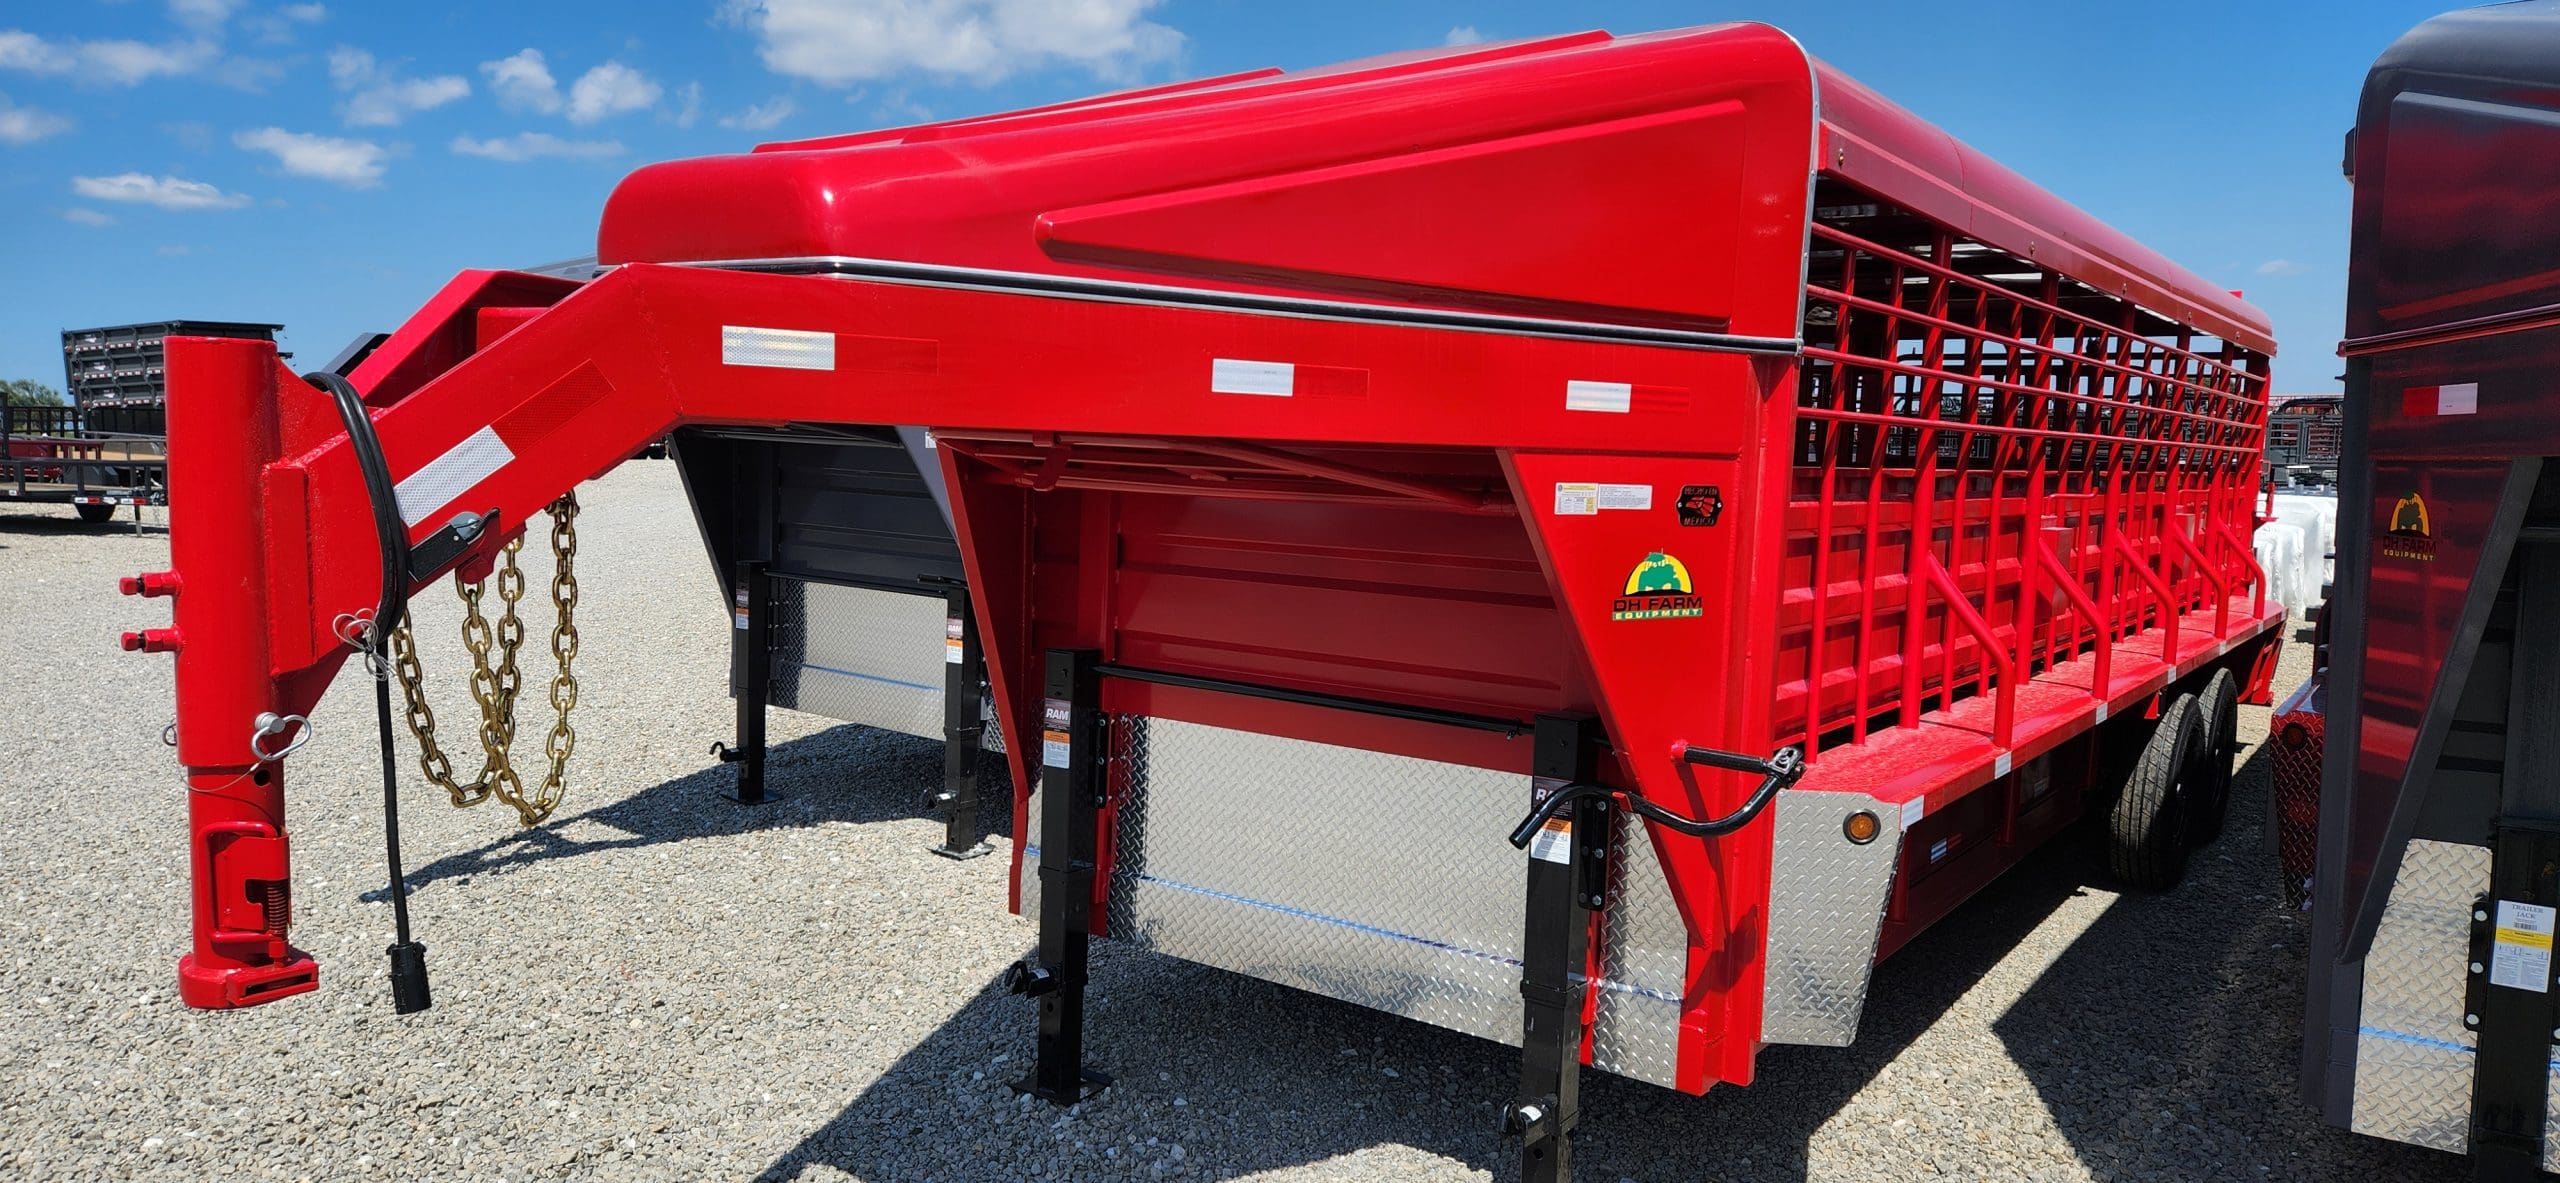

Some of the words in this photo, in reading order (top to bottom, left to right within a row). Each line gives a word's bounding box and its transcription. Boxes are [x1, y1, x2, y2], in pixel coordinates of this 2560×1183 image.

[2384, 549, 2434, 561] EQUIPMENT
[1613, 600, 1641, 612] DH
[1648, 597, 1702, 611] FARM
[1615, 608, 1700, 619] EQUIPMENT
[1046, 708, 1069, 720] RAM
[2512, 904, 2543, 913] TRAILER
[2517, 911, 2536, 919] JACK
